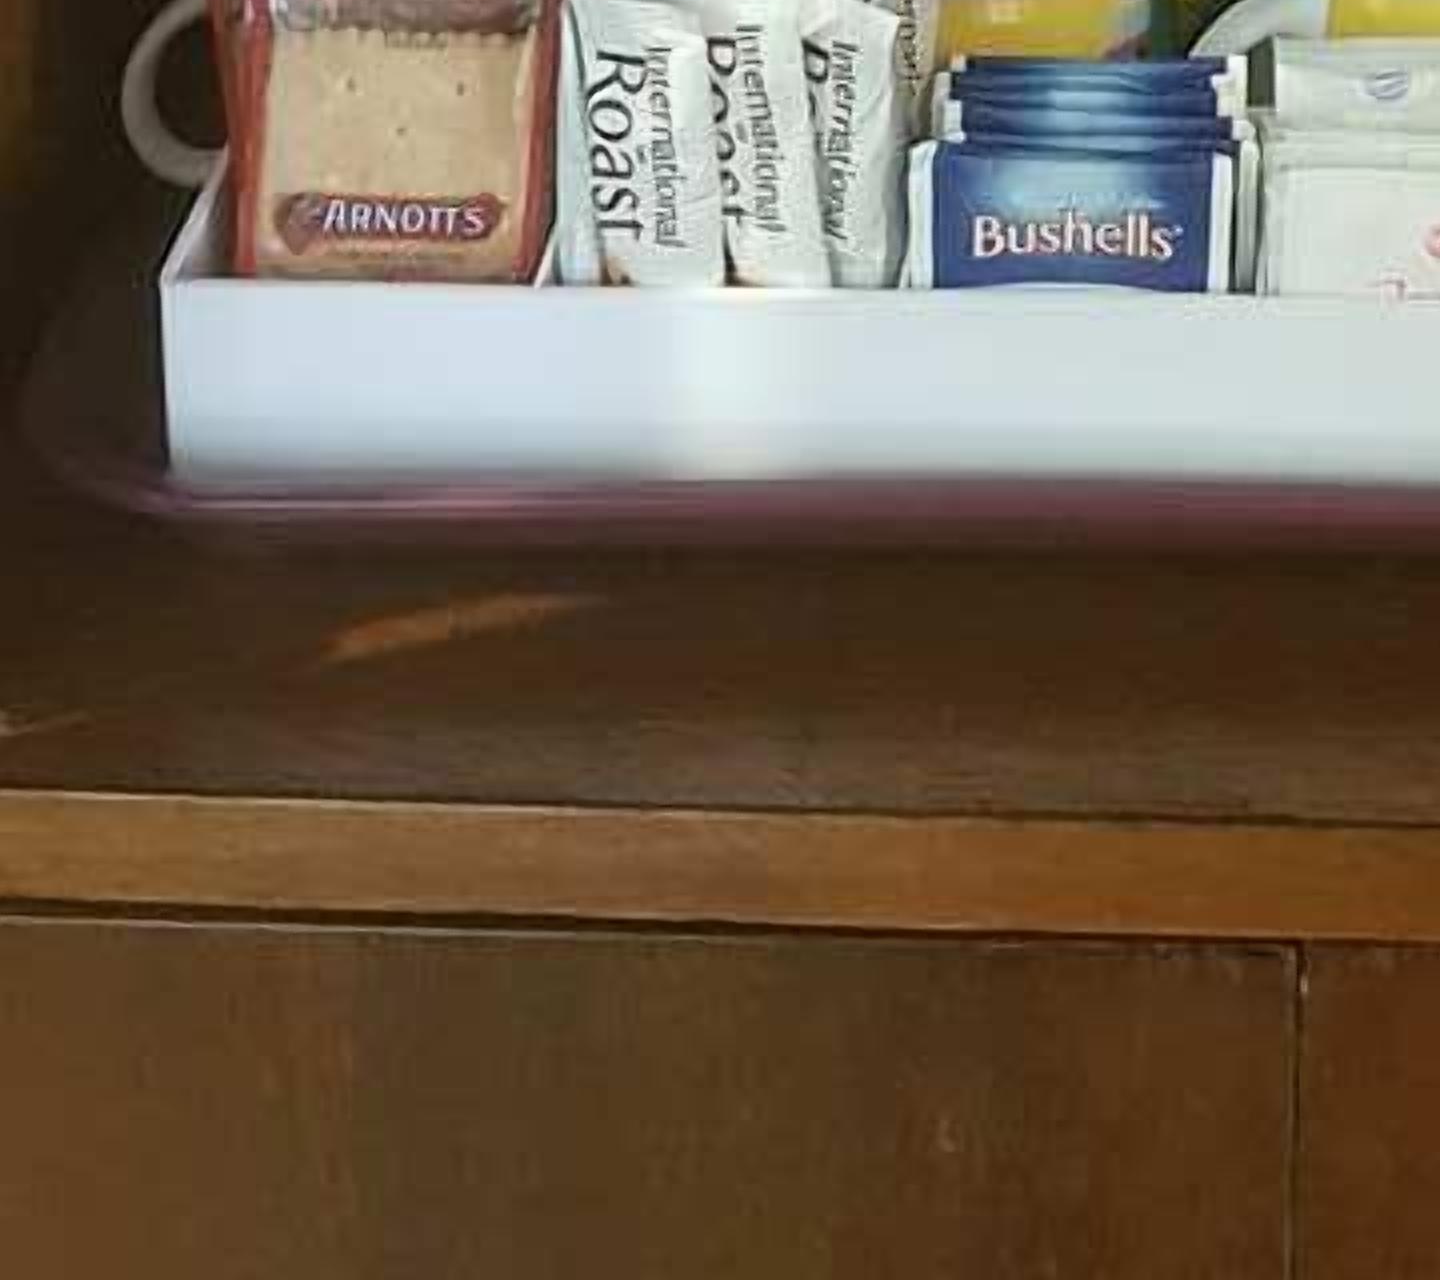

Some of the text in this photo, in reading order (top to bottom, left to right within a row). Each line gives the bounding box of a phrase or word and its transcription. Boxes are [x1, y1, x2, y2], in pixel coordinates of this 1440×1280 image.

[584, 50, 648, 242] Roast
[642, 45, 690, 249] International
[971, 210, 1176, 262] Bushells
